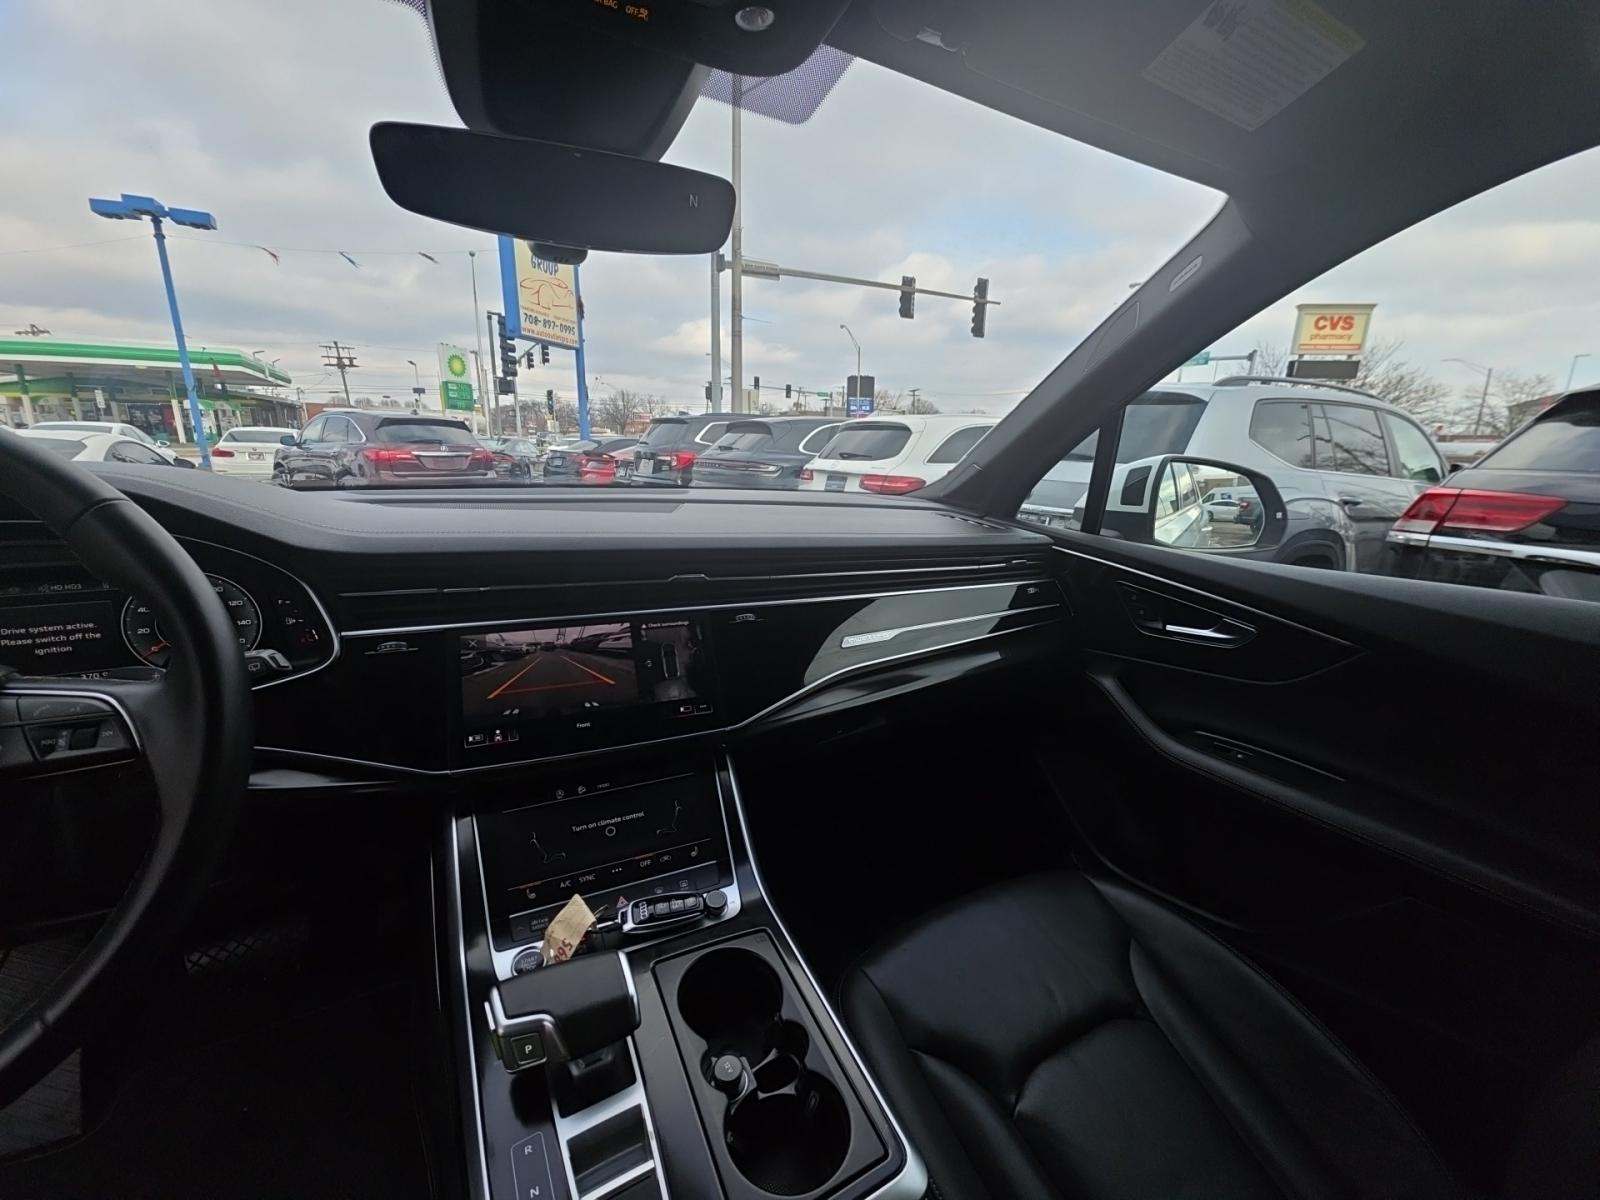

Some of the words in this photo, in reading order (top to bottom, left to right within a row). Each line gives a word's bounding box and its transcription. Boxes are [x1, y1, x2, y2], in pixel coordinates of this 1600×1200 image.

[689, 193, 699, 209] N
[523, 312, 577, 337] 708-897-0995
[1314, 315, 1354, 331] CVS
[0, 628, 26, 636] Drive
[29, 624, 64, 635] system
[66, 622, 97, 631] active.
[0, 638, 33, 647] Please
[35, 633, 67, 645] switch
[69, 632, 83, 641] off
[85, 631, 102, 640] the
[34, 645, 73, 656] ignition
[572, 824, 588, 832] Turn
[597, 816, 622, 827] climate
[622, 810, 645, 821] control
[639, 858, 652, 868] OFF
[559, 880, 571, 889] A/C
[579, 872, 597, 883] SYNC
[524, 1044, 533, 1055] P
[524, 1144, 533, 1155] R
[529, 1185, 540, 1198] N
